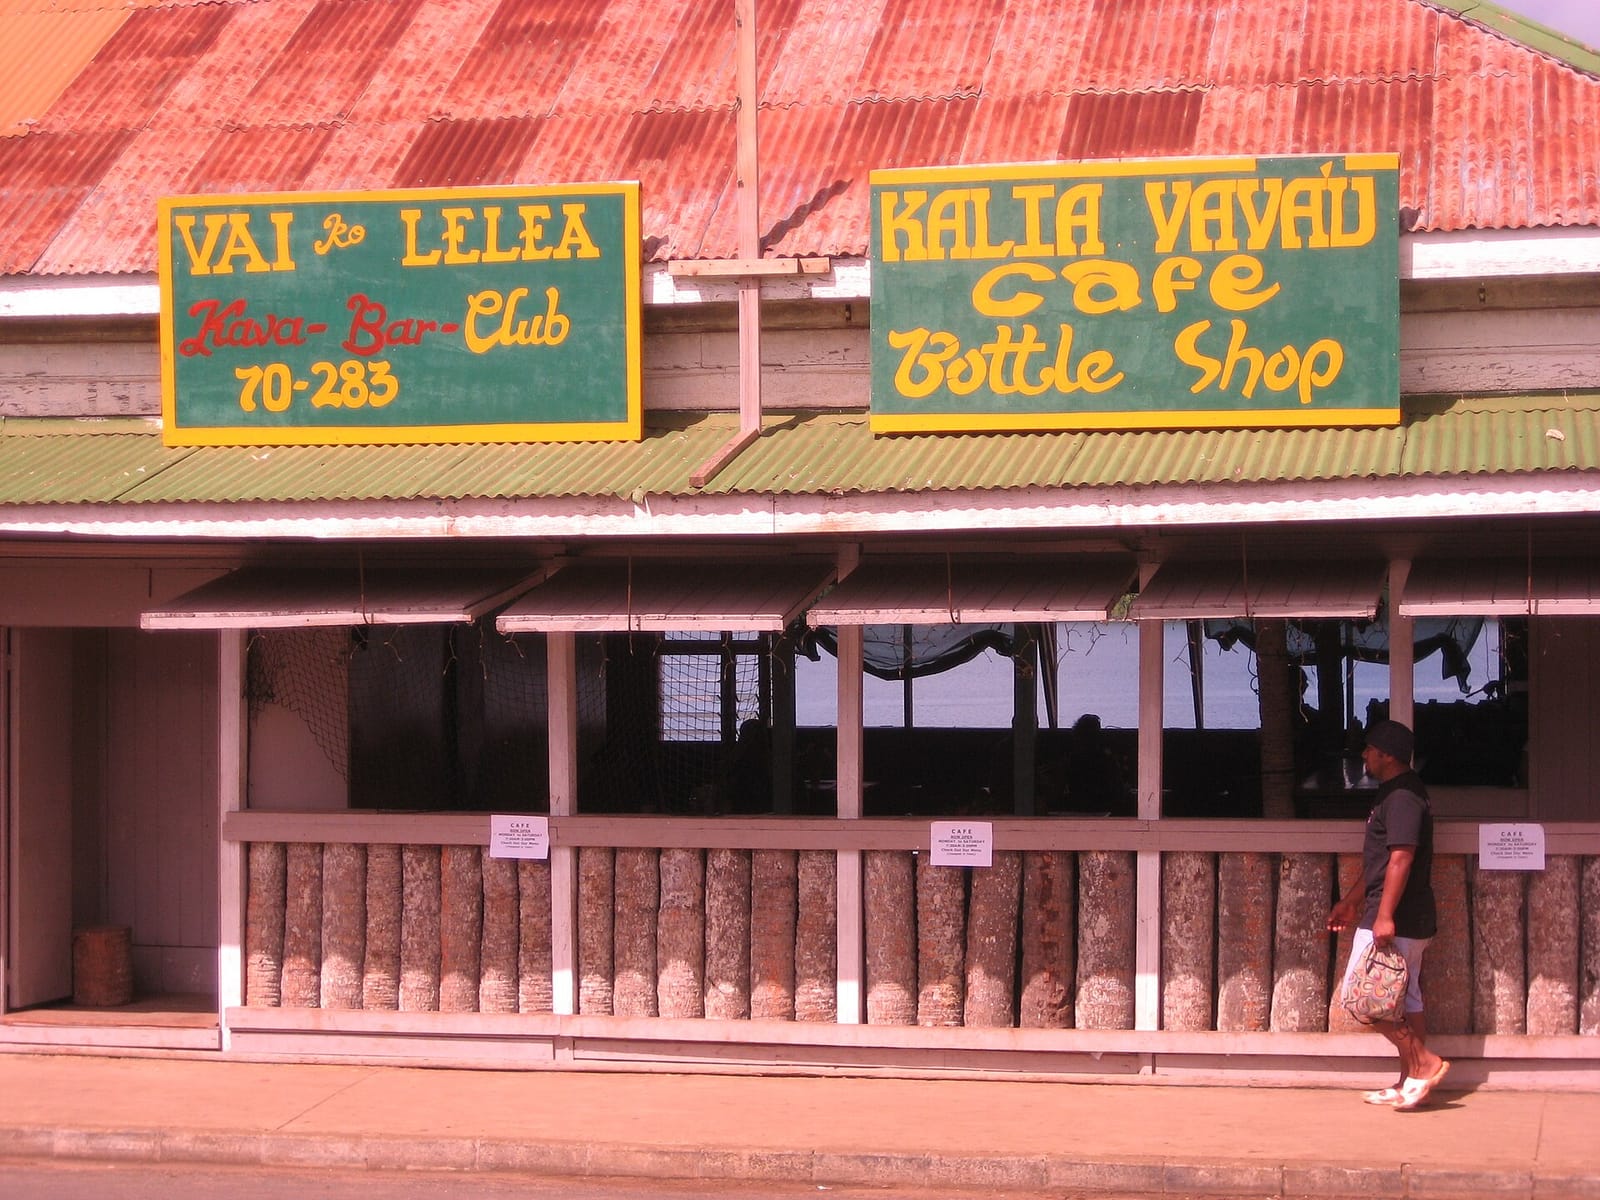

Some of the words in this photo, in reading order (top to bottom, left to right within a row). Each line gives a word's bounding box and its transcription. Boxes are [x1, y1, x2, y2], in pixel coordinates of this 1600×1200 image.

[174, 211, 296, 275] VAI
[313, 213, 365, 255] ko
[400, 203, 600, 266] LELEA
[880, 183, 1105, 262] KALIA
[235, 360, 399, 412] 70-283
[888, 323, 1124, 398] Bottle
[1174, 319, 1343, 404] Shop
